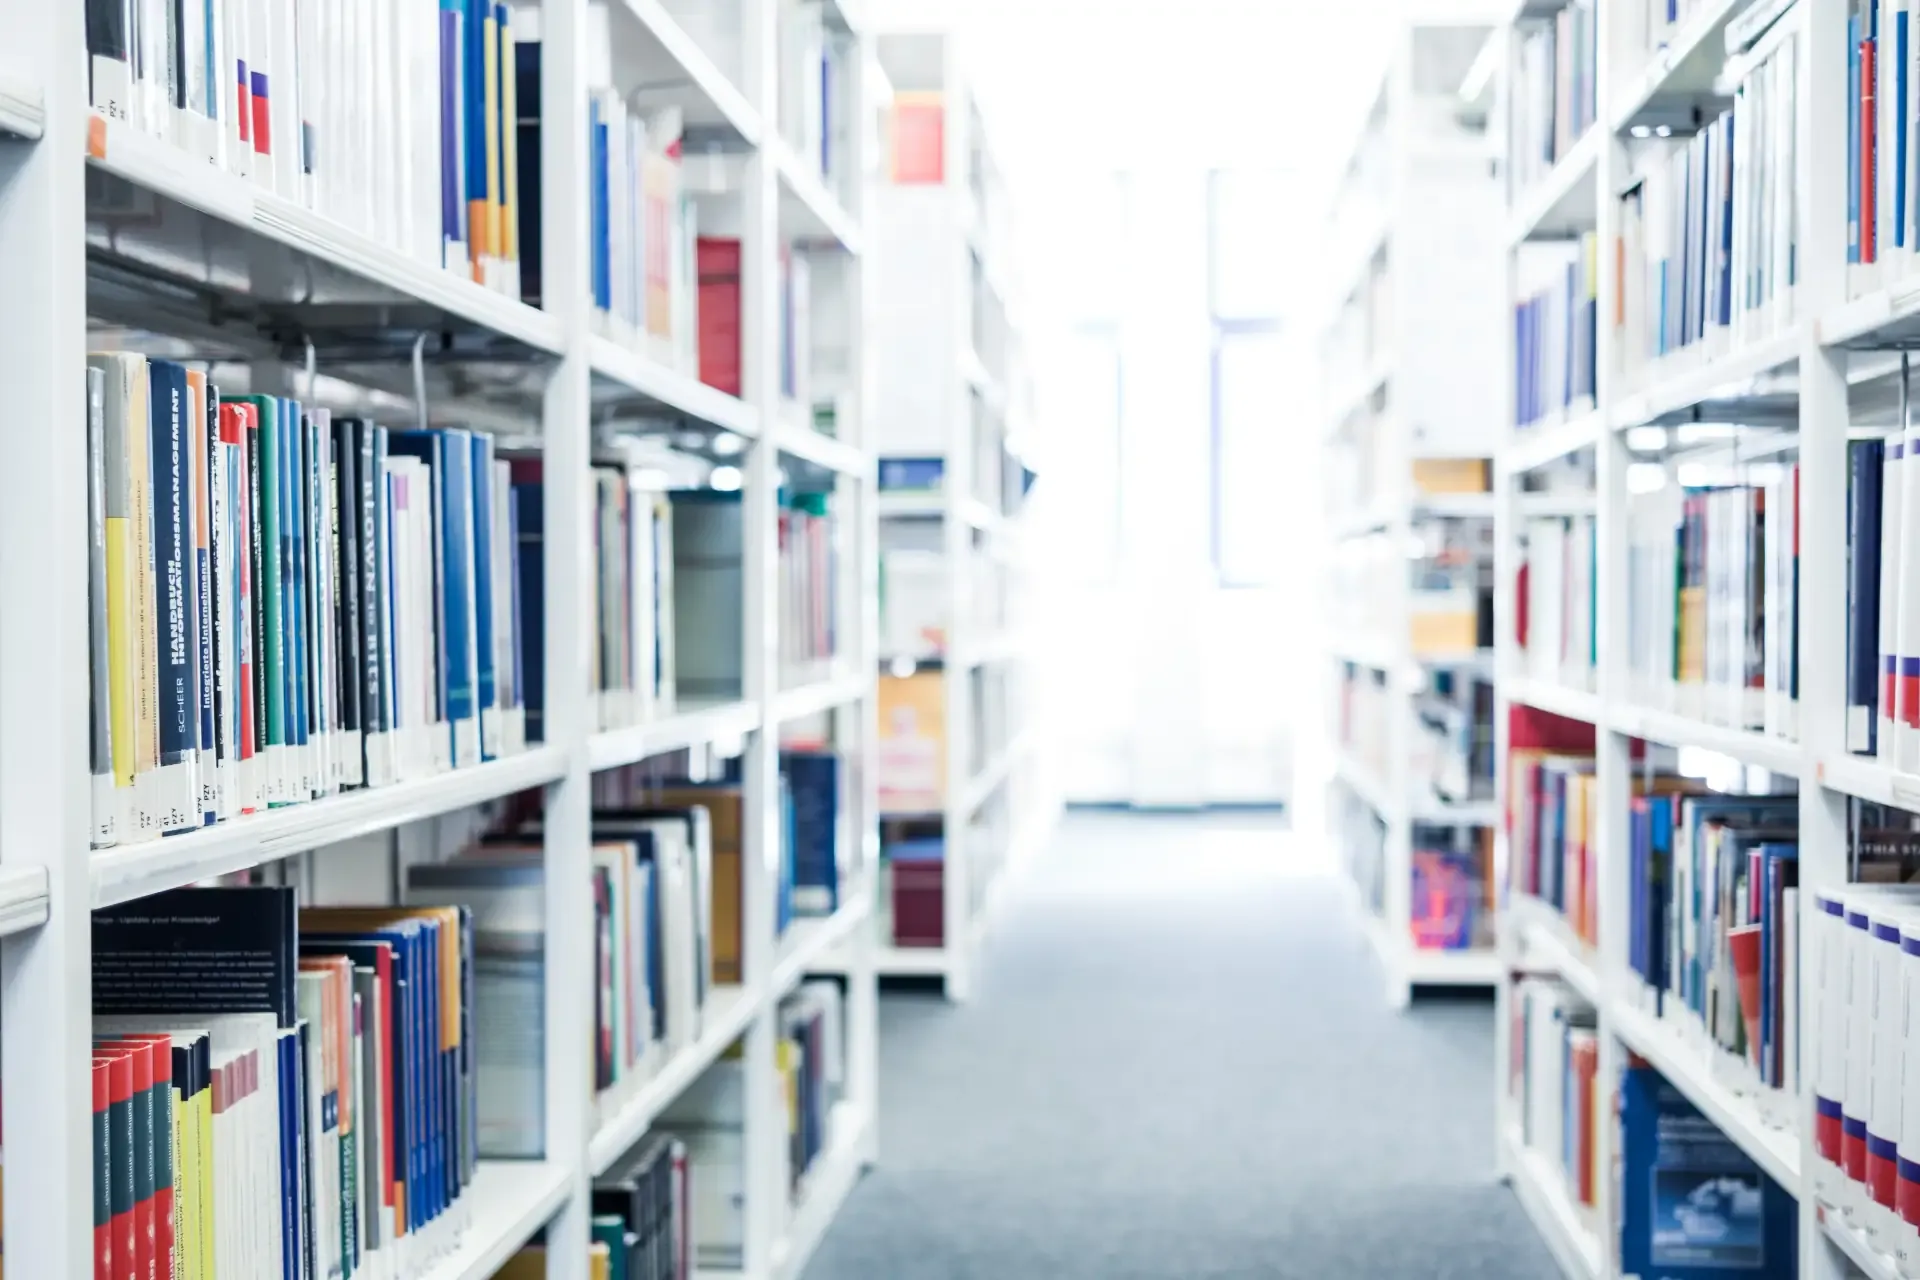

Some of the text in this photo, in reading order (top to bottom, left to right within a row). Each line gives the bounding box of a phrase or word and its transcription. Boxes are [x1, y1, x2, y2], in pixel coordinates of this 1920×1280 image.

[171, 386, 188, 665] INFORMATIONSMANAGEMENT
[168, 559, 180, 665] HANDBUCH
[199, 556, 212, 709] Integrierte Unternehmens-
[176, 677, 187, 733] SCHEER
